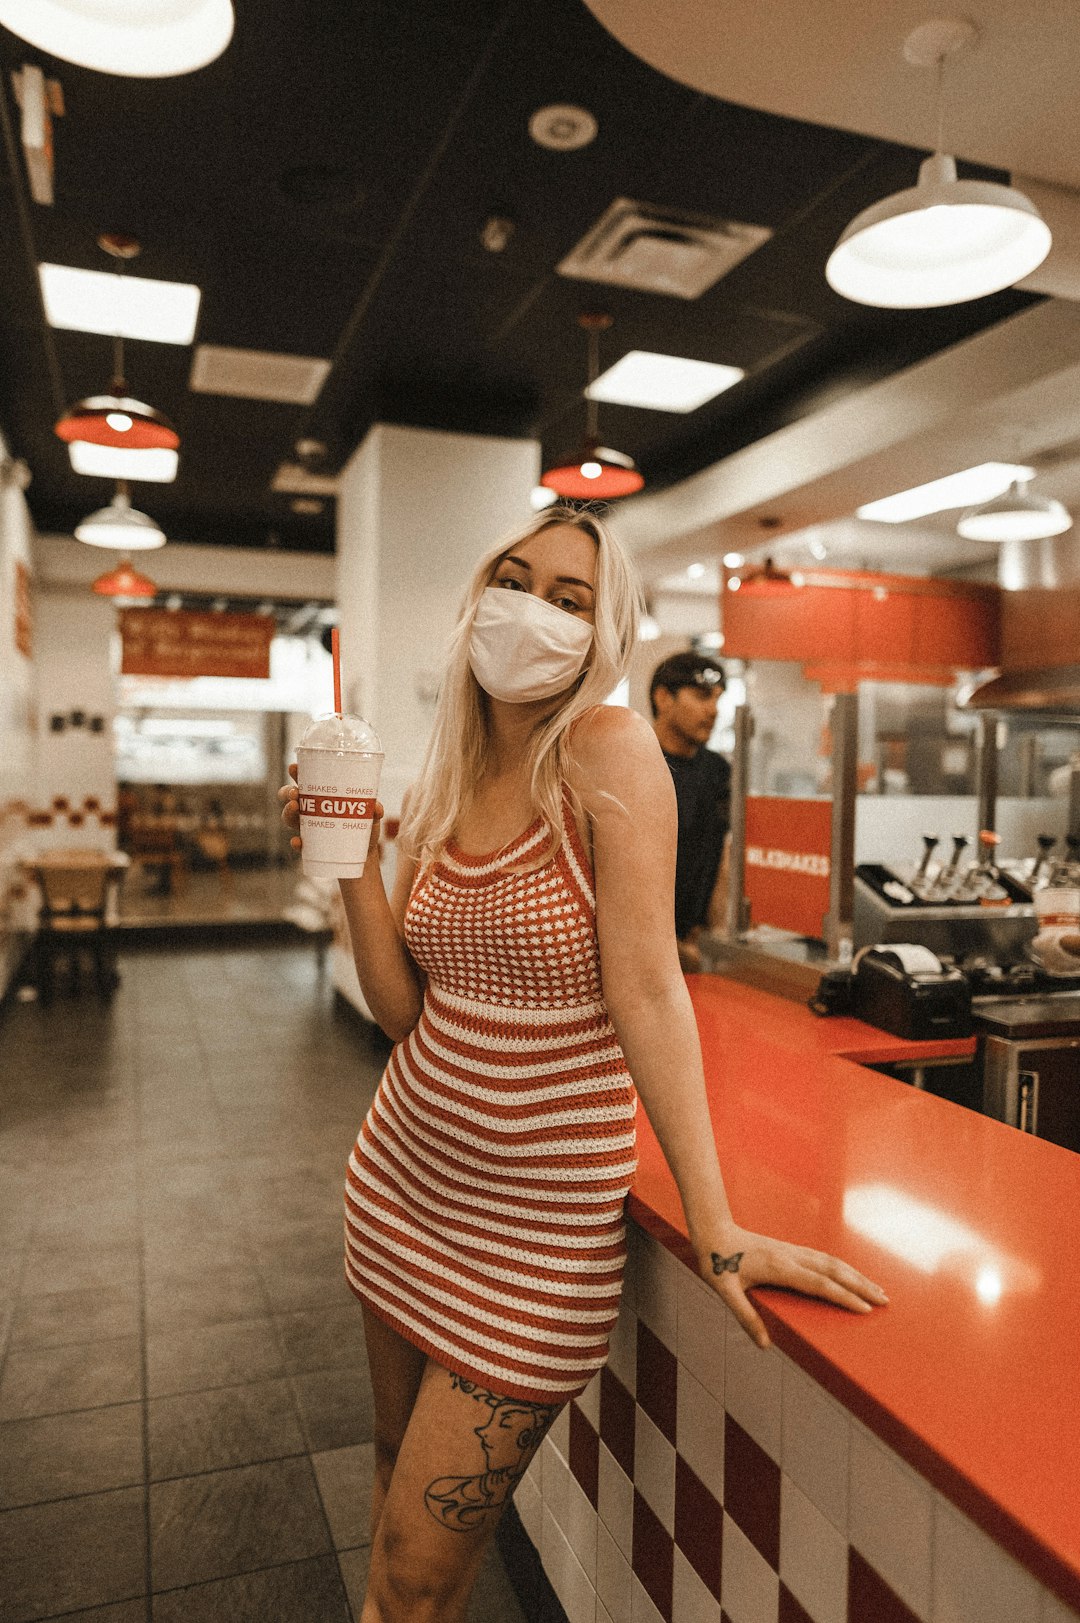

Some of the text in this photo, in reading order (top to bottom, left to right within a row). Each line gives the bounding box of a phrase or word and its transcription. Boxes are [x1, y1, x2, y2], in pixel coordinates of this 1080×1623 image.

[307, 784, 338, 793] SHAKES
[345, 787, 373, 795] SHAKES
[320, 800, 366, 815] GUYS
[307, 820, 335, 829] SHAKES
[342, 822, 368, 830] SHAKES
